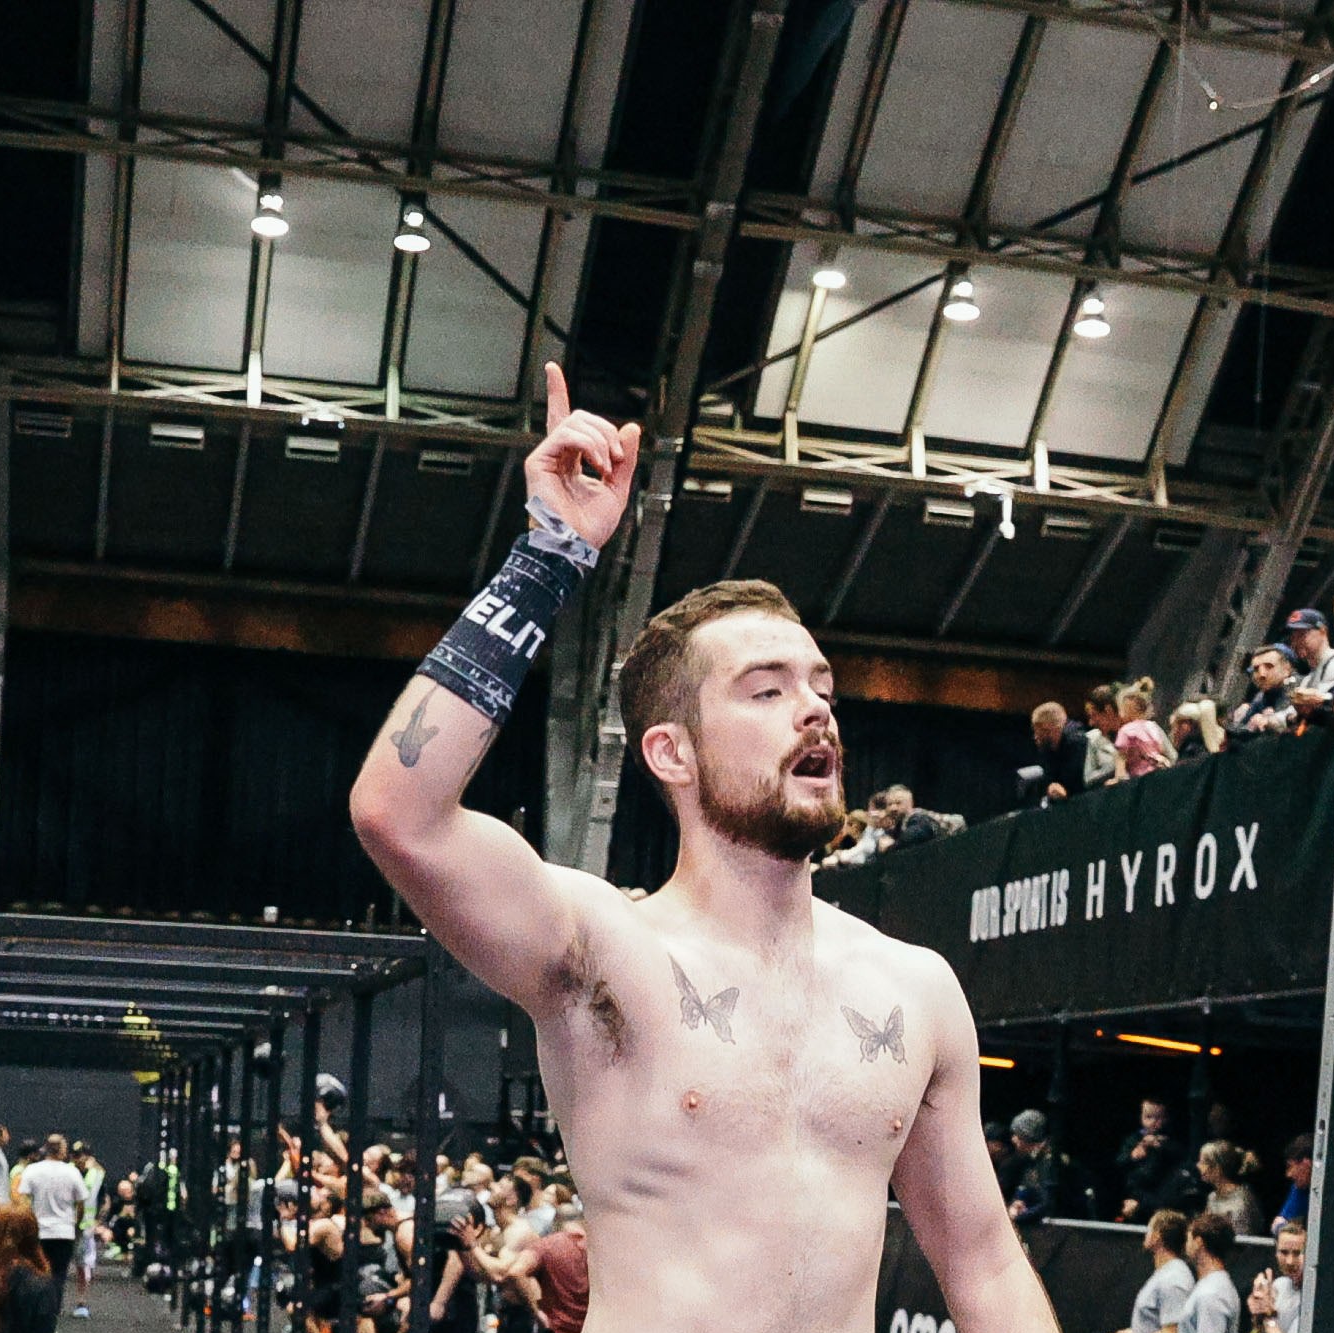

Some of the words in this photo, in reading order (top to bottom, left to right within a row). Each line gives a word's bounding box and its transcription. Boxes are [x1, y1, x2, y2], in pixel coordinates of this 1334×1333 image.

[970, 886, 1000, 942] OUR
[1002, 873, 1050, 936] SPORT
[1050, 868, 1070, 926] IS
[1085, 821, 1259, 920] HYROX
